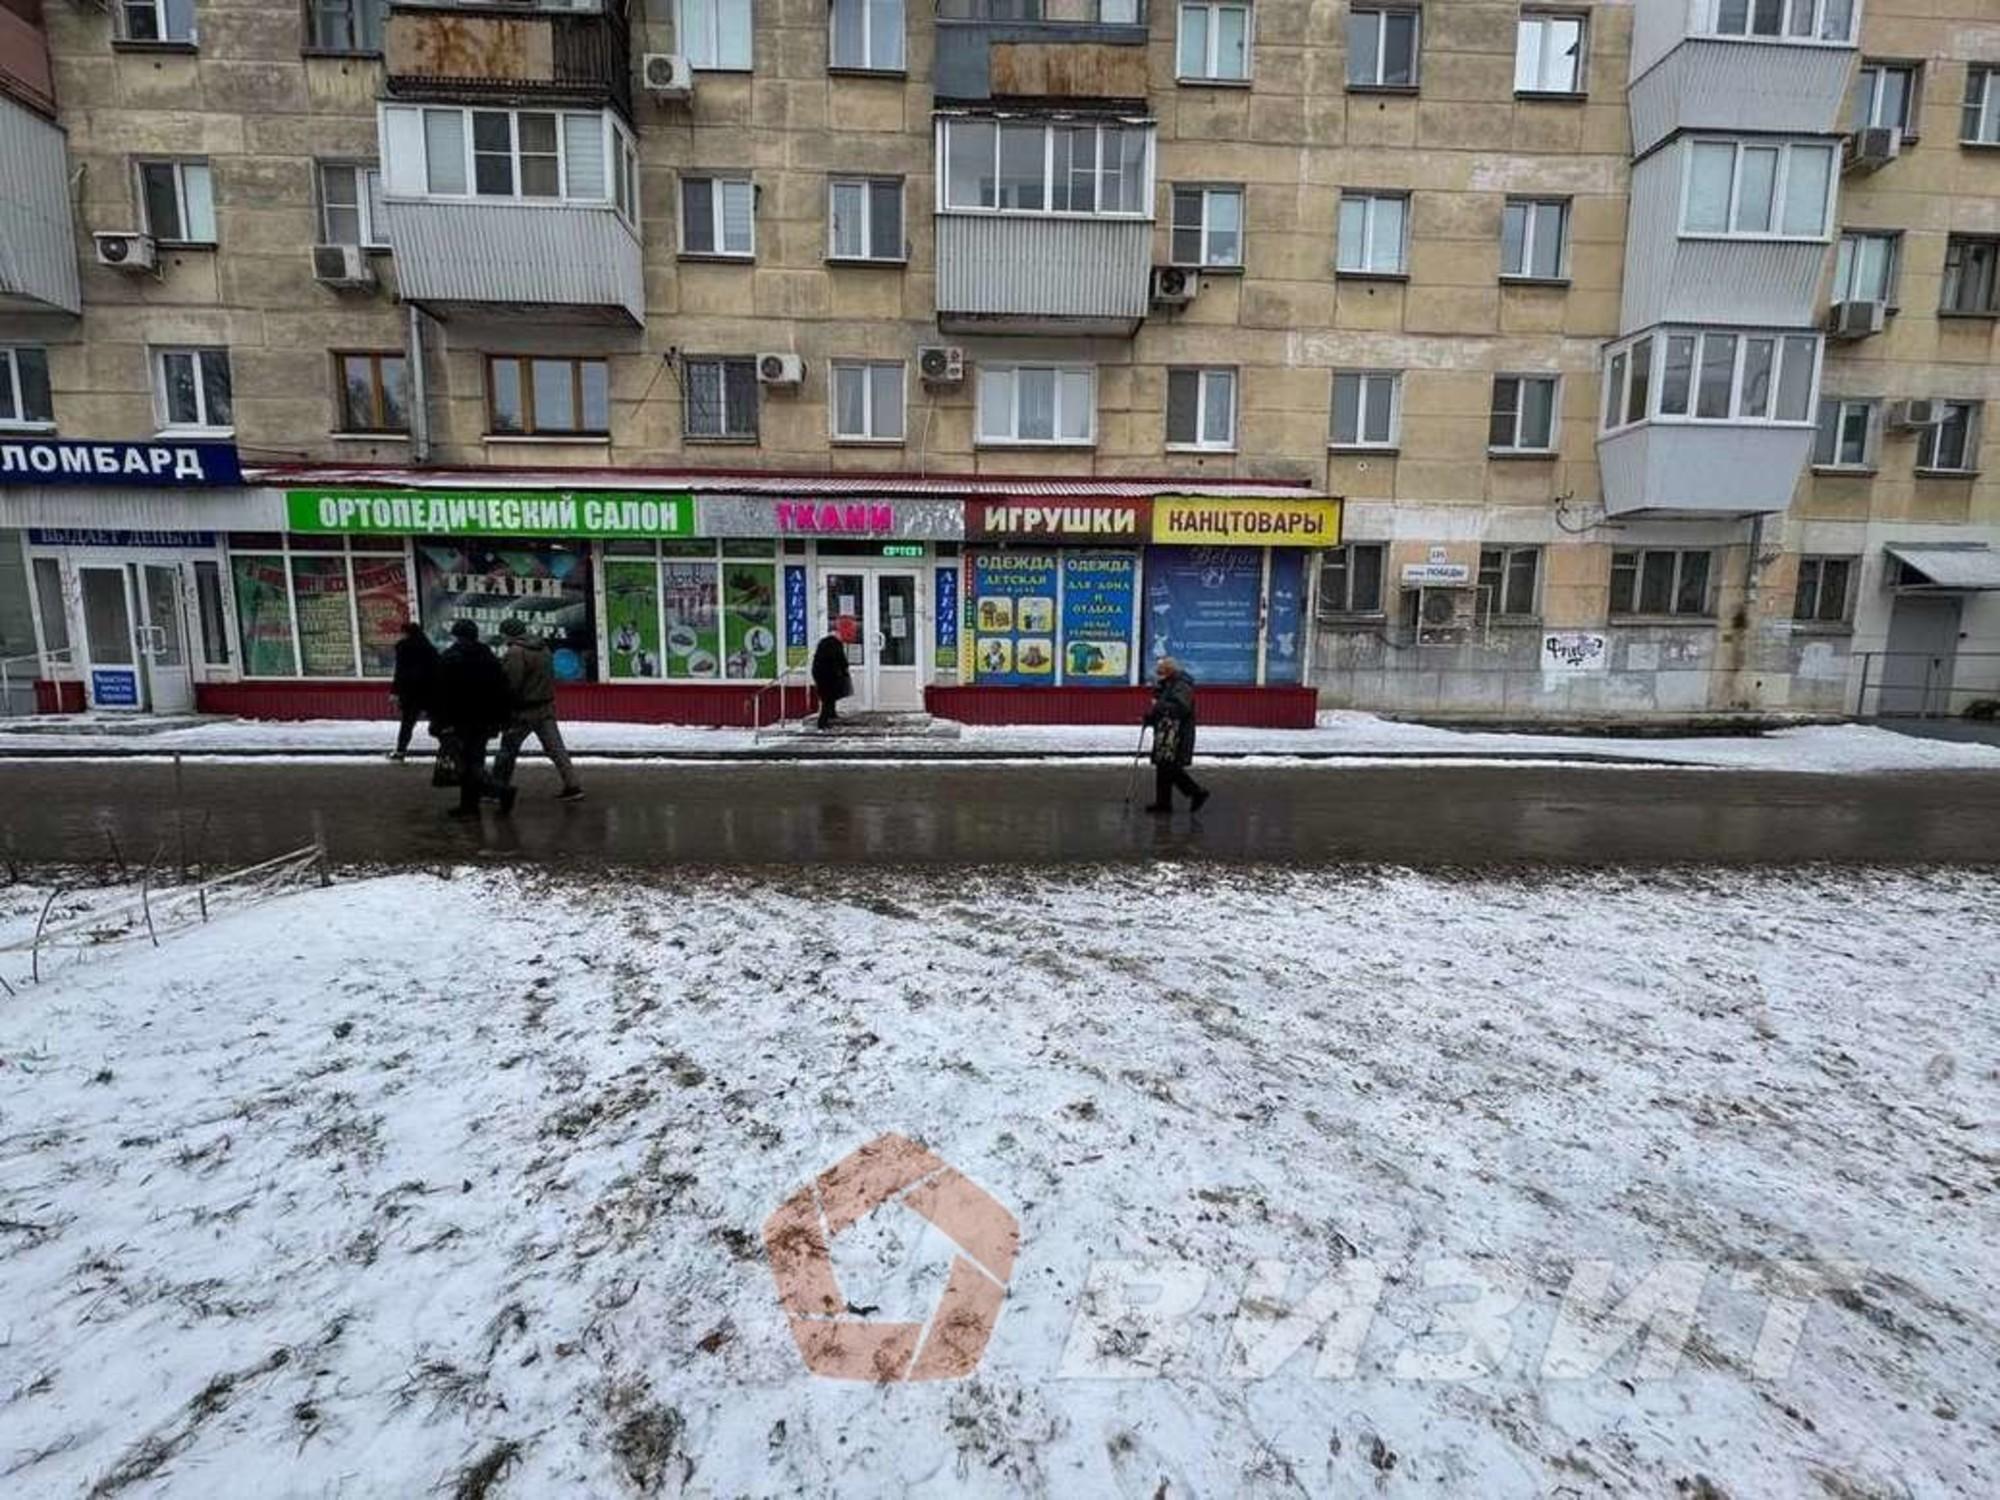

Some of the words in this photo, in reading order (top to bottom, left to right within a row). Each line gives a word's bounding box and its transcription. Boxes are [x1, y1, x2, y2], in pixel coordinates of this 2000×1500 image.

[2, 445, 205, 480] ЛОМБАРД
[319, 494, 577, 533] ОРТОПЕДИЧЕСКИЙ
[584, 500, 678, 532] САЛОН
[776, 500, 895, 532] ТКАНИ
[985, 506, 1136, 534] ИГРУШКИ
[1168, 510, 1324, 536] КАНЦТОВАРЫ
[977, 556, 1055, 572] ОДЕЖДА
[1068, 560, 1131, 572] ОДЕЖДА
[443, 572, 563, 598] ТКАНИ
[985, 575, 1047, 585] ДЕТСКАЯ
[453, 605, 557, 624] ШВЕЙНАЯ
[788, 569, 805, 645] АТЕЛЬЕ
[938, 571, 954, 646] АТЕЛЬЕ
[1072, 605, 1124, 615] ОТДЫХА
